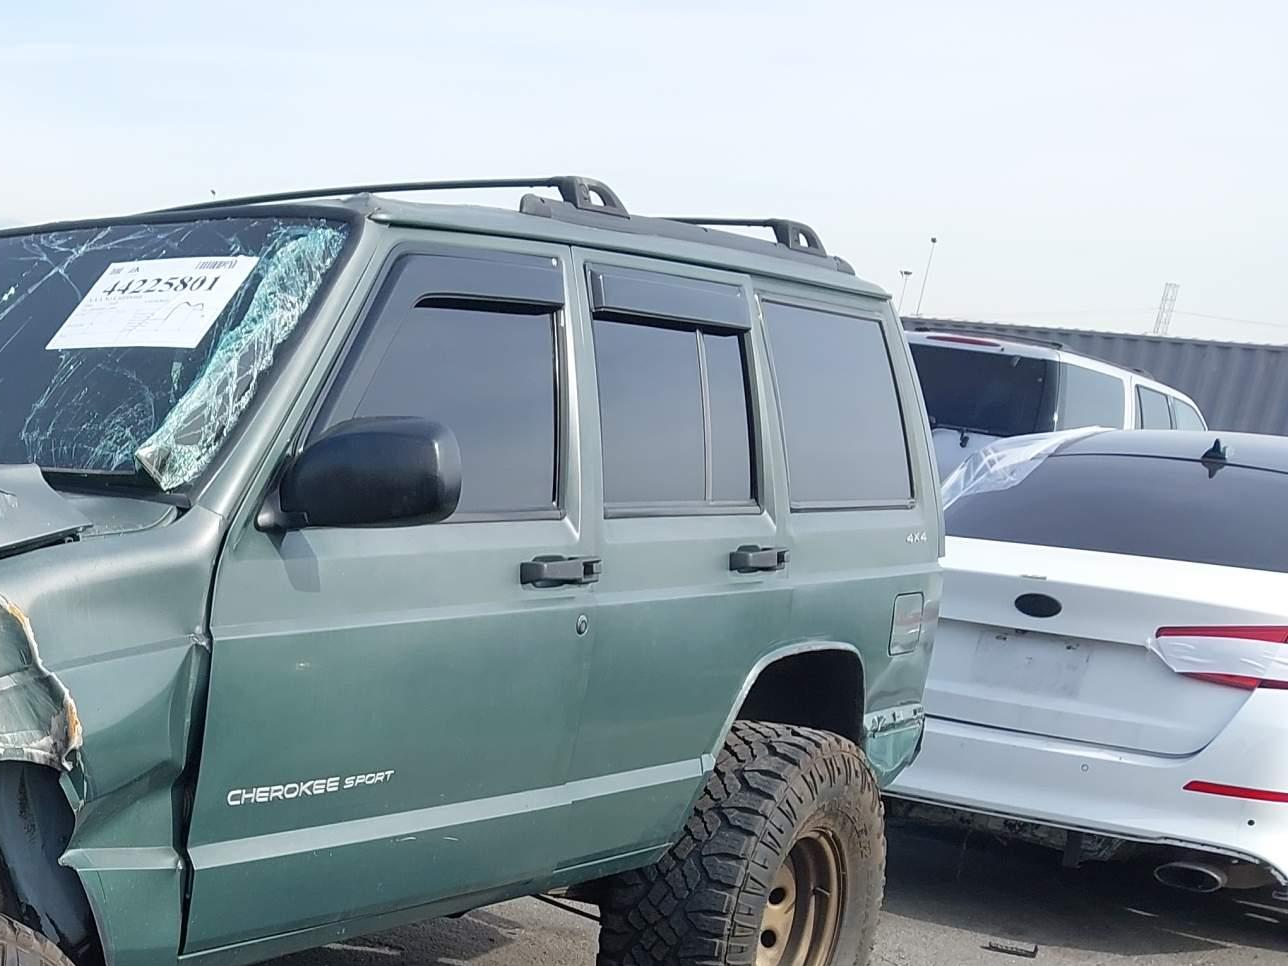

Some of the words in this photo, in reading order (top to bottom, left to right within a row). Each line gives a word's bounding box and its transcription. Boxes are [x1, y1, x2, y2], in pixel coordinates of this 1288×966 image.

[103, 275, 221, 296] 44225801
[227, 776, 341, 806] CHEROKEE
[343, 770, 395, 789] SPORT
